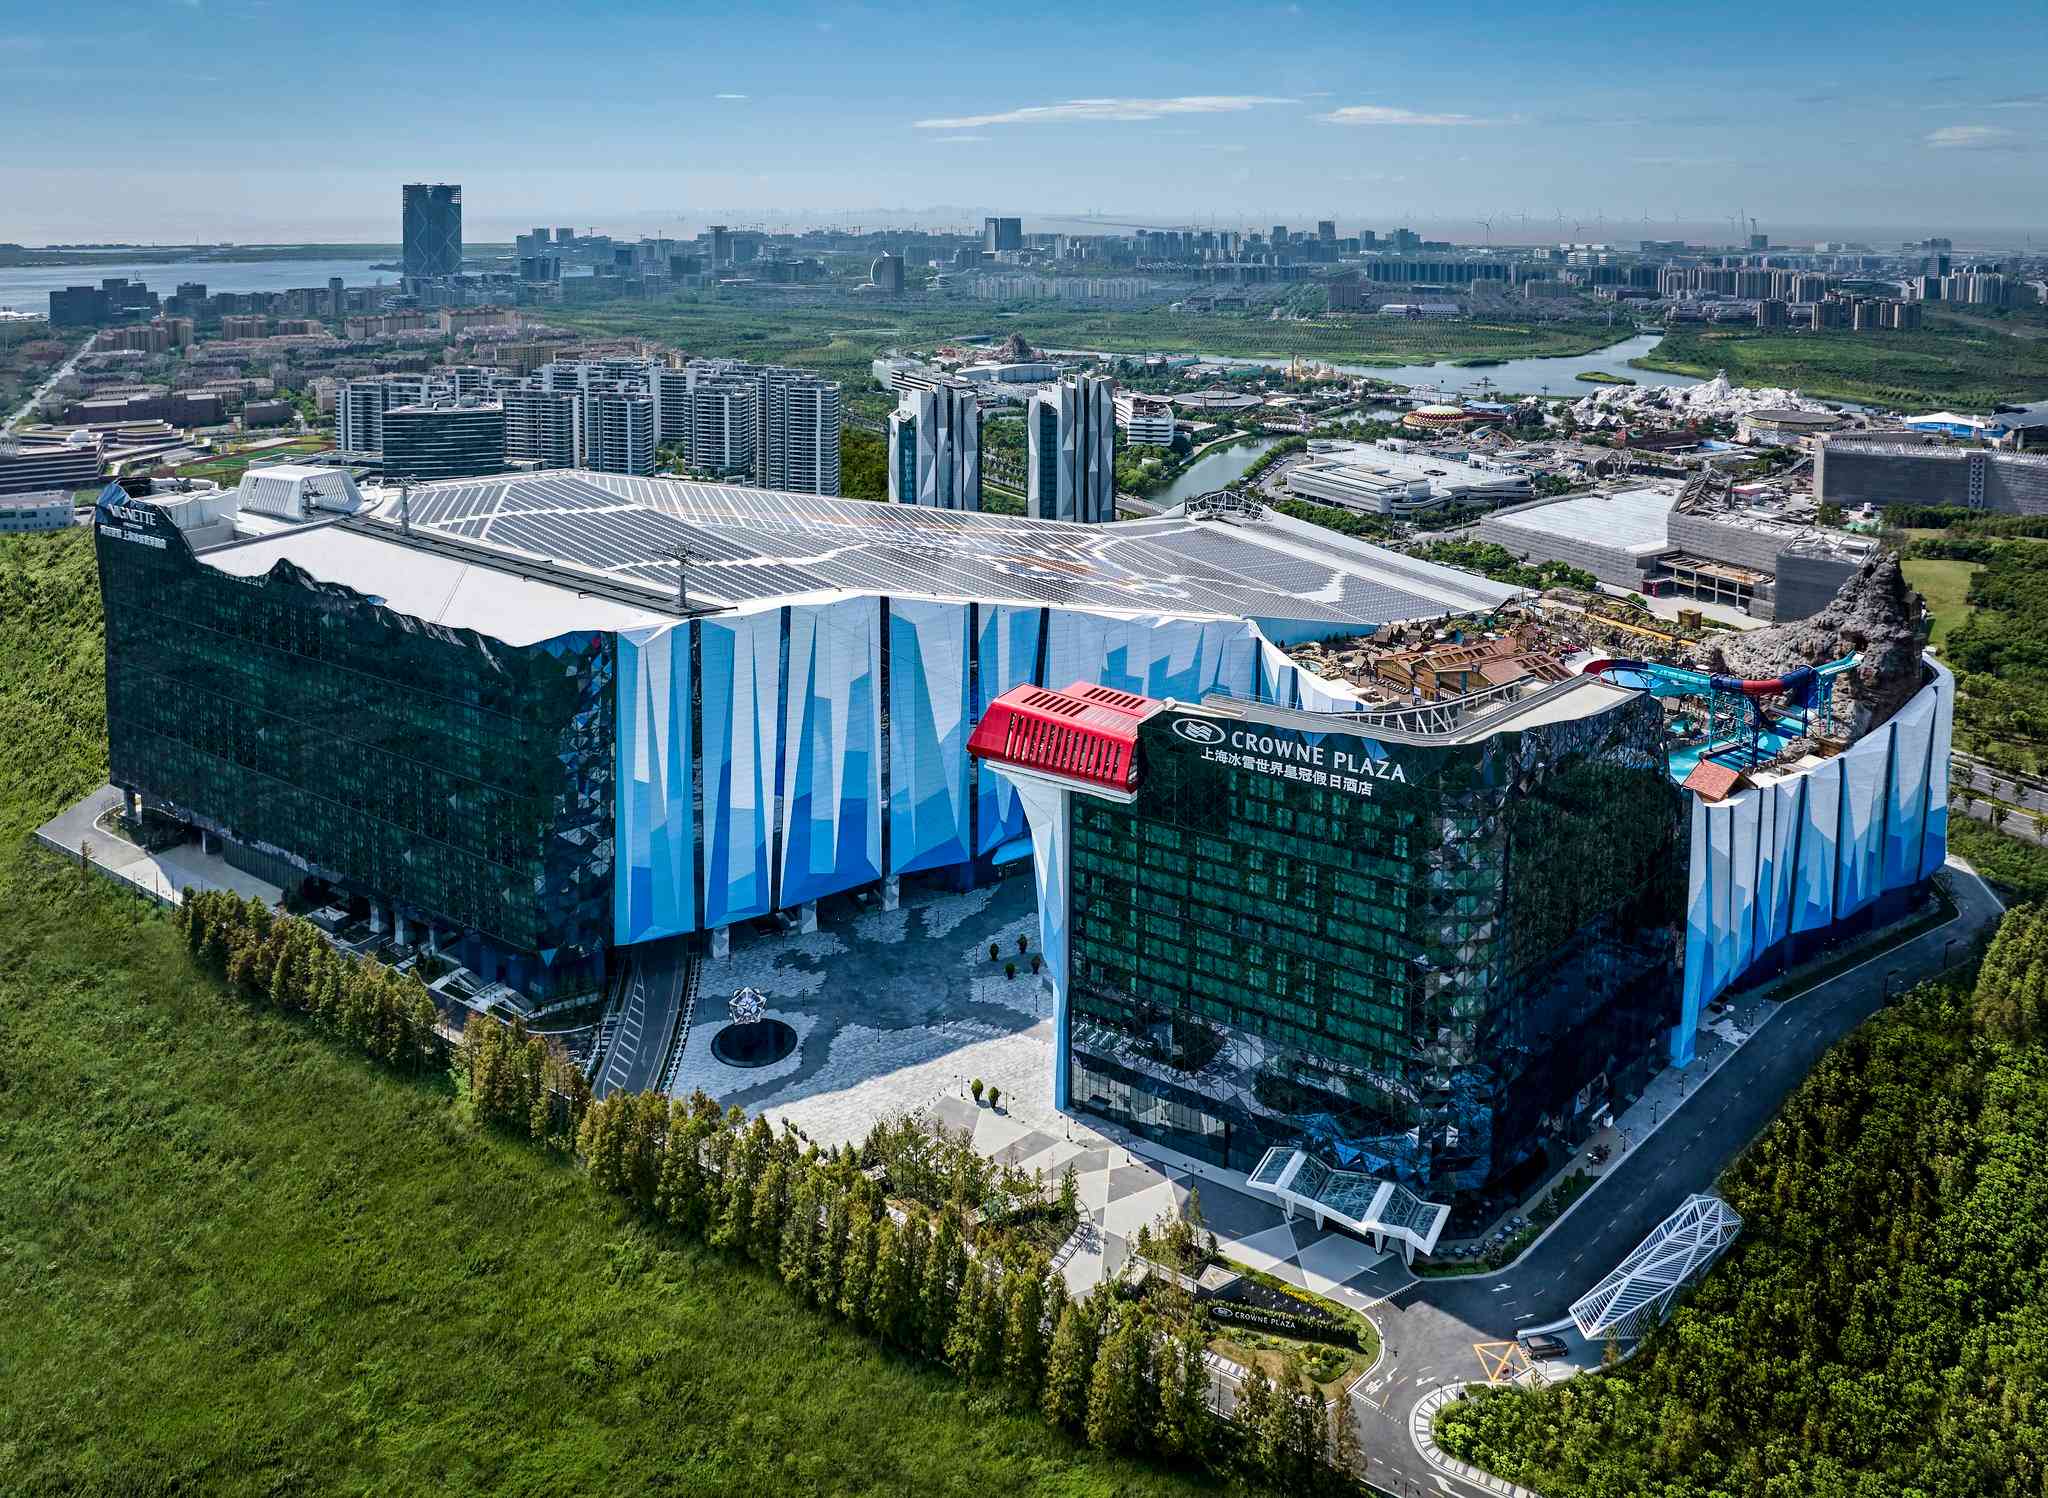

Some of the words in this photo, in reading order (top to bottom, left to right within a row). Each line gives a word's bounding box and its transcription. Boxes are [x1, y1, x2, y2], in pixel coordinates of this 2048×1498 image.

[1201, 747, 1373, 797] 上海冰雪世界皇冠假日酒店
[1231, 731, 1324, 766] CROWNE
[1333, 751, 1406, 784] PLAZA
[1234, 1311, 1268, 1324] CROWNE
[1270, 1318, 1296, 1329] PLAZA
